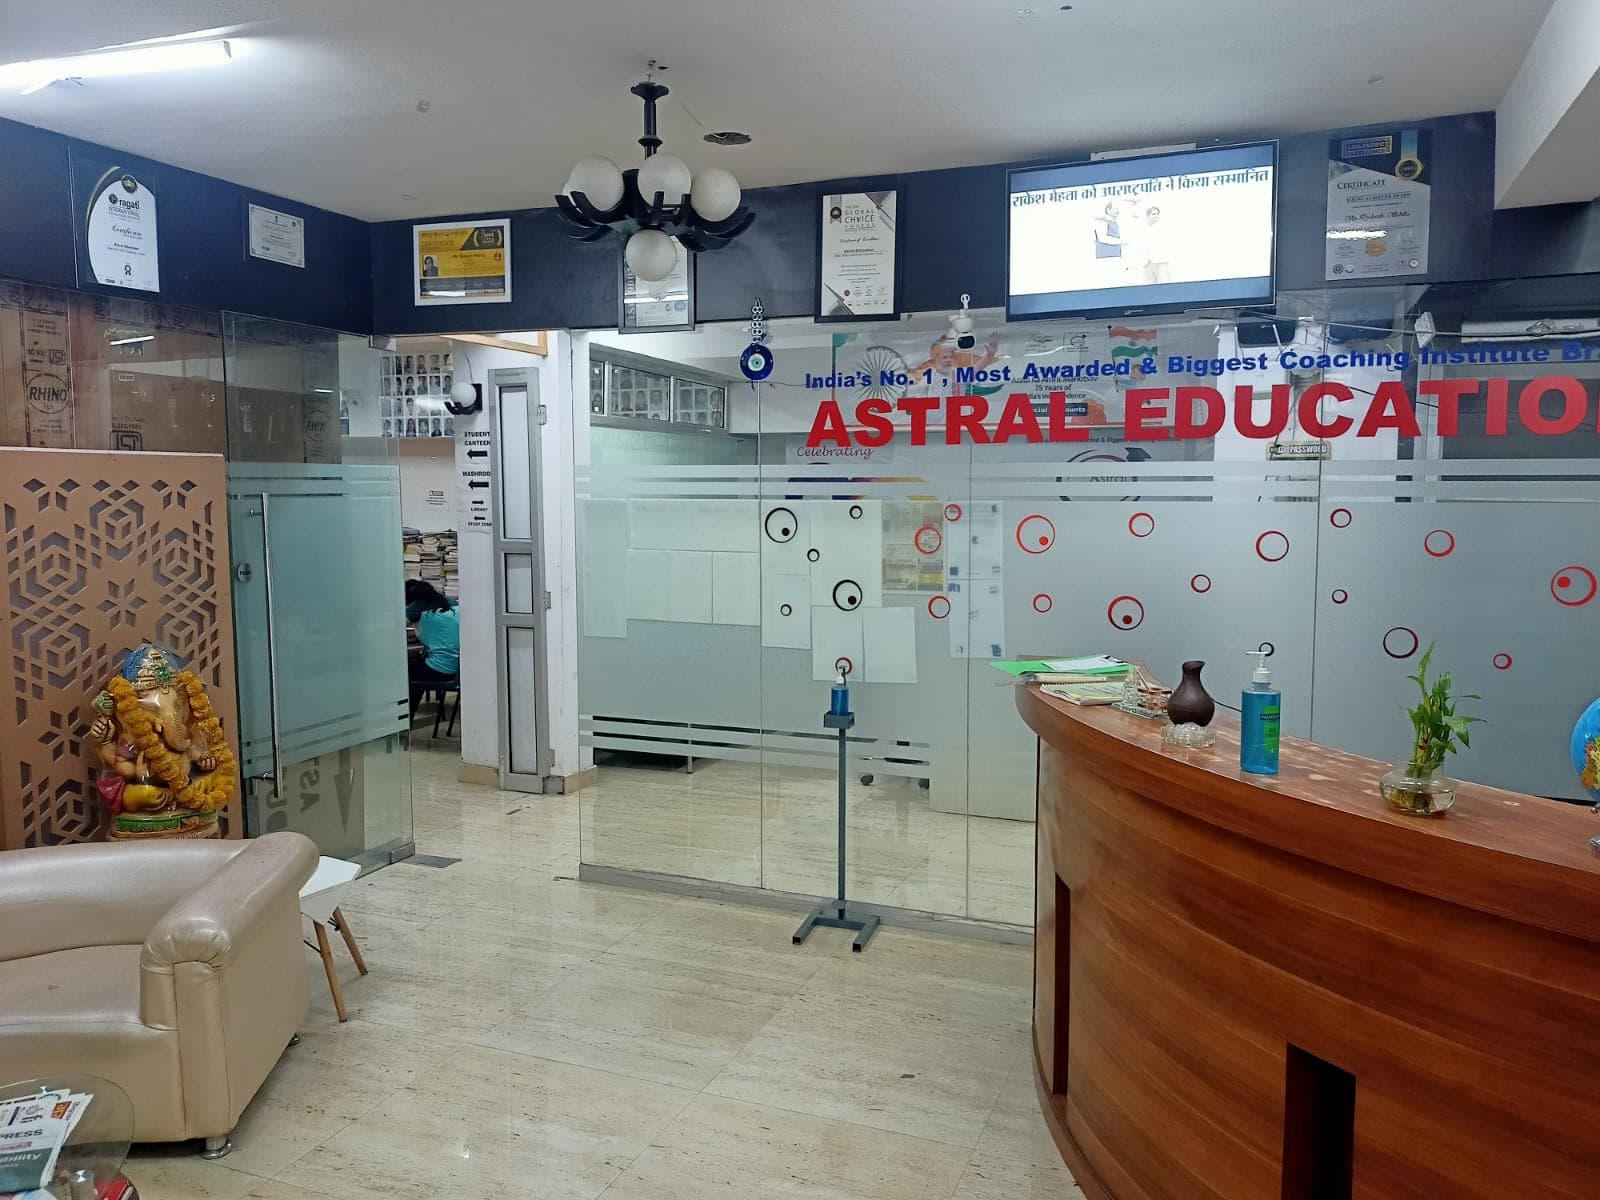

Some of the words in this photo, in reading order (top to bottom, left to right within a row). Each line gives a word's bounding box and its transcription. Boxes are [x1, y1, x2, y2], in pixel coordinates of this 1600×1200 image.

[1012, 191, 1046, 207] राकेश
[1048, 188, 1079, 203] मेहता
[1081, 183, 1097, 199] को
[1102, 177, 1162, 197] उपराष्ट्रपति
[1165, 176, 1175, 191] ने
[1178, 174, 1209, 190] किया
[1213, 168, 1269, 187] सम्मानित
[805, 372, 872, 389] India's
[880, 370, 915, 387] No.
[923, 368, 933, 386] 1
[956, 366, 1012, 384] Most
[1022, 358, 1130, 380] Awarded
[1141, 357, 1157, 375] &
[1168, 353, 1268, 377] Biggest
[1279, 349, 1410, 372] Coaching
[1421, 345, 1550, 365] Institute
[29, 386, 68, 402] RHINO
[1045, 384, 1063, 392] Years
[1064, 383, 1072, 391] of
[806, 391, 1090, 448] ASTRAL
[1124, 374, 1600, 441] EDUCATIO
[796, 446, 874, 460] Celebrating
[1290, 445, 1327, 454] PASSWORD
